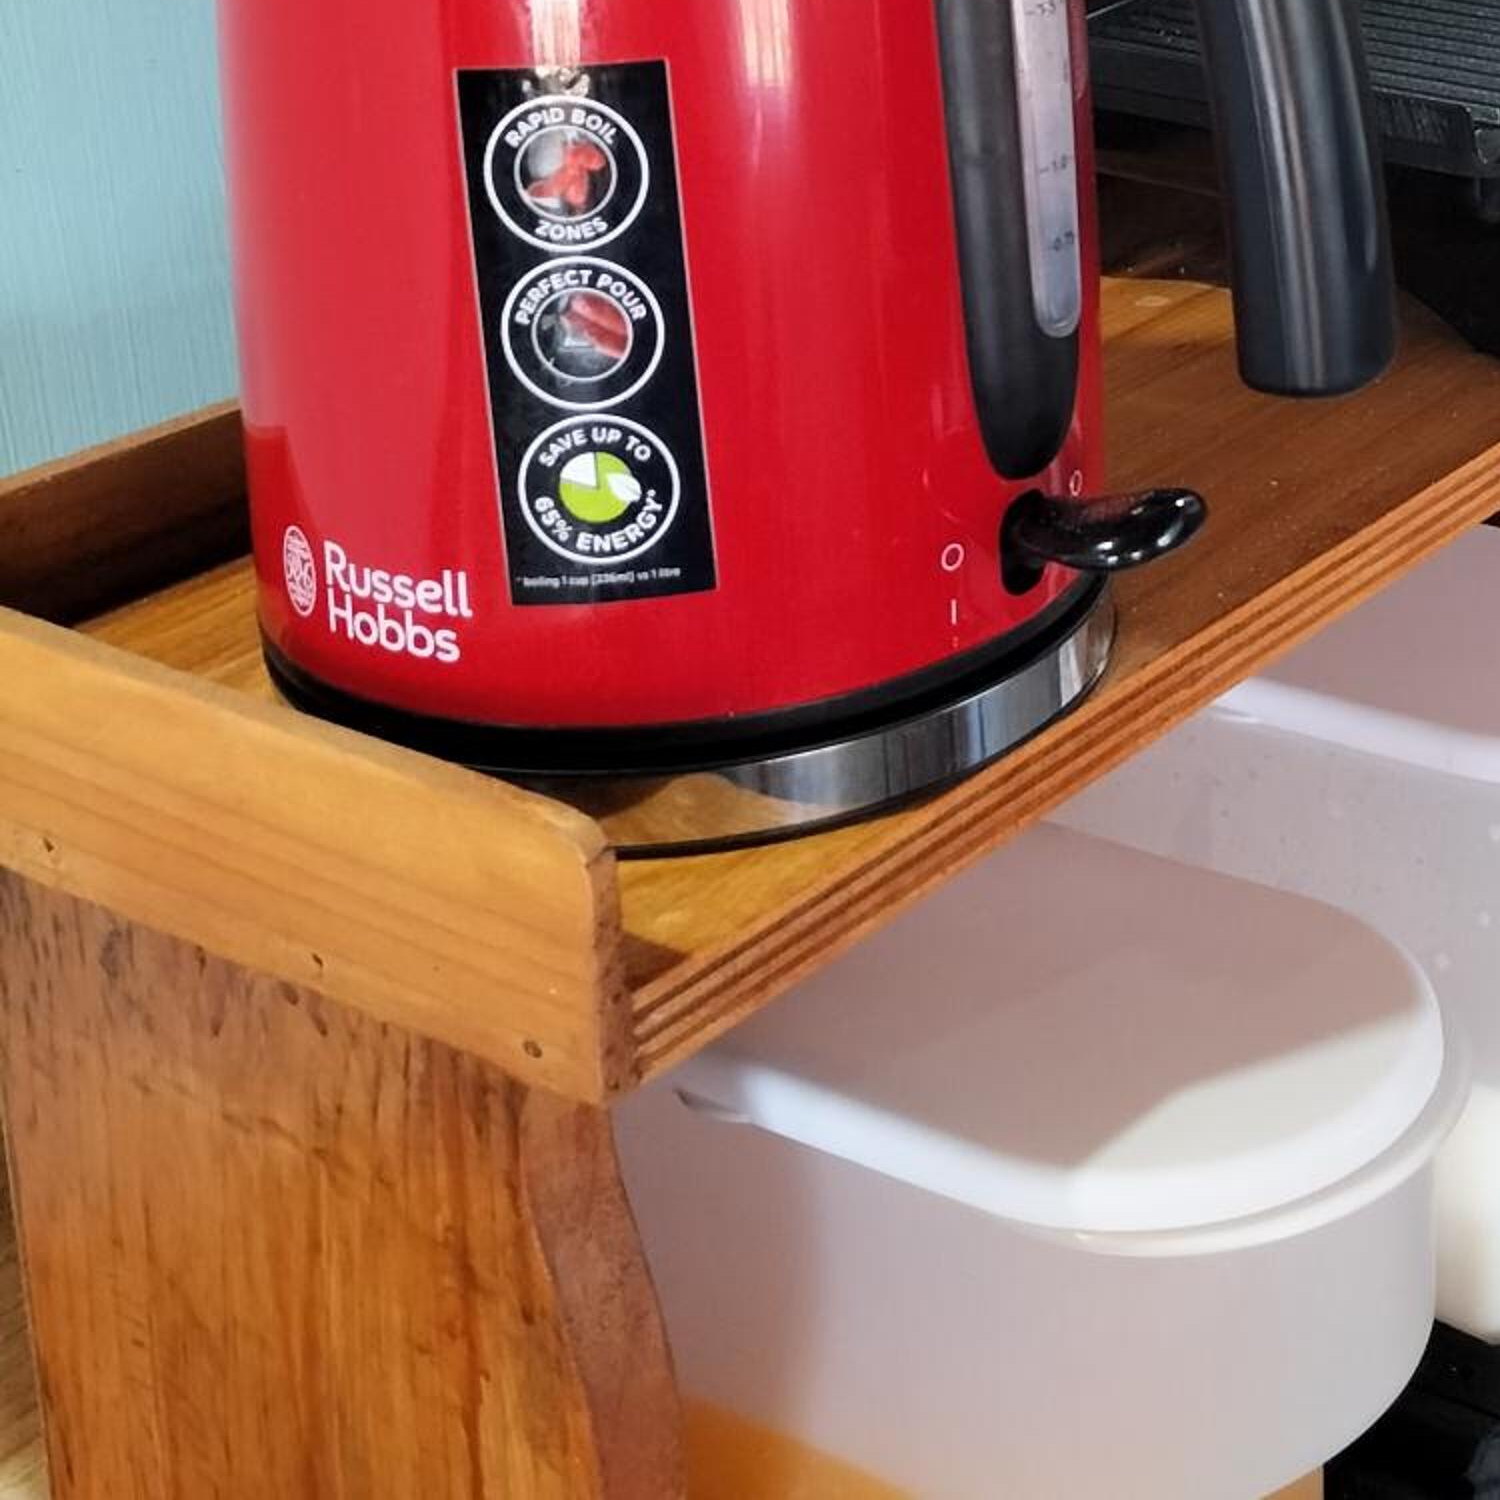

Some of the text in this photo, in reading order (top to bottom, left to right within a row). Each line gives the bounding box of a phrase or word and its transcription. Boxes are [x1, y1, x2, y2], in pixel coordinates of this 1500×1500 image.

[504, 107, 618, 148] RAPID BOIL
[534, 217, 608, 242] ZONES
[514, 269, 648, 326] PERFECT POUR
[538, 426, 652, 467] SAVE UP TO
[534, 496, 573, 542] 65%
[323, 539, 474, 619] Russell
[326, 586, 462, 663] Hobbs
